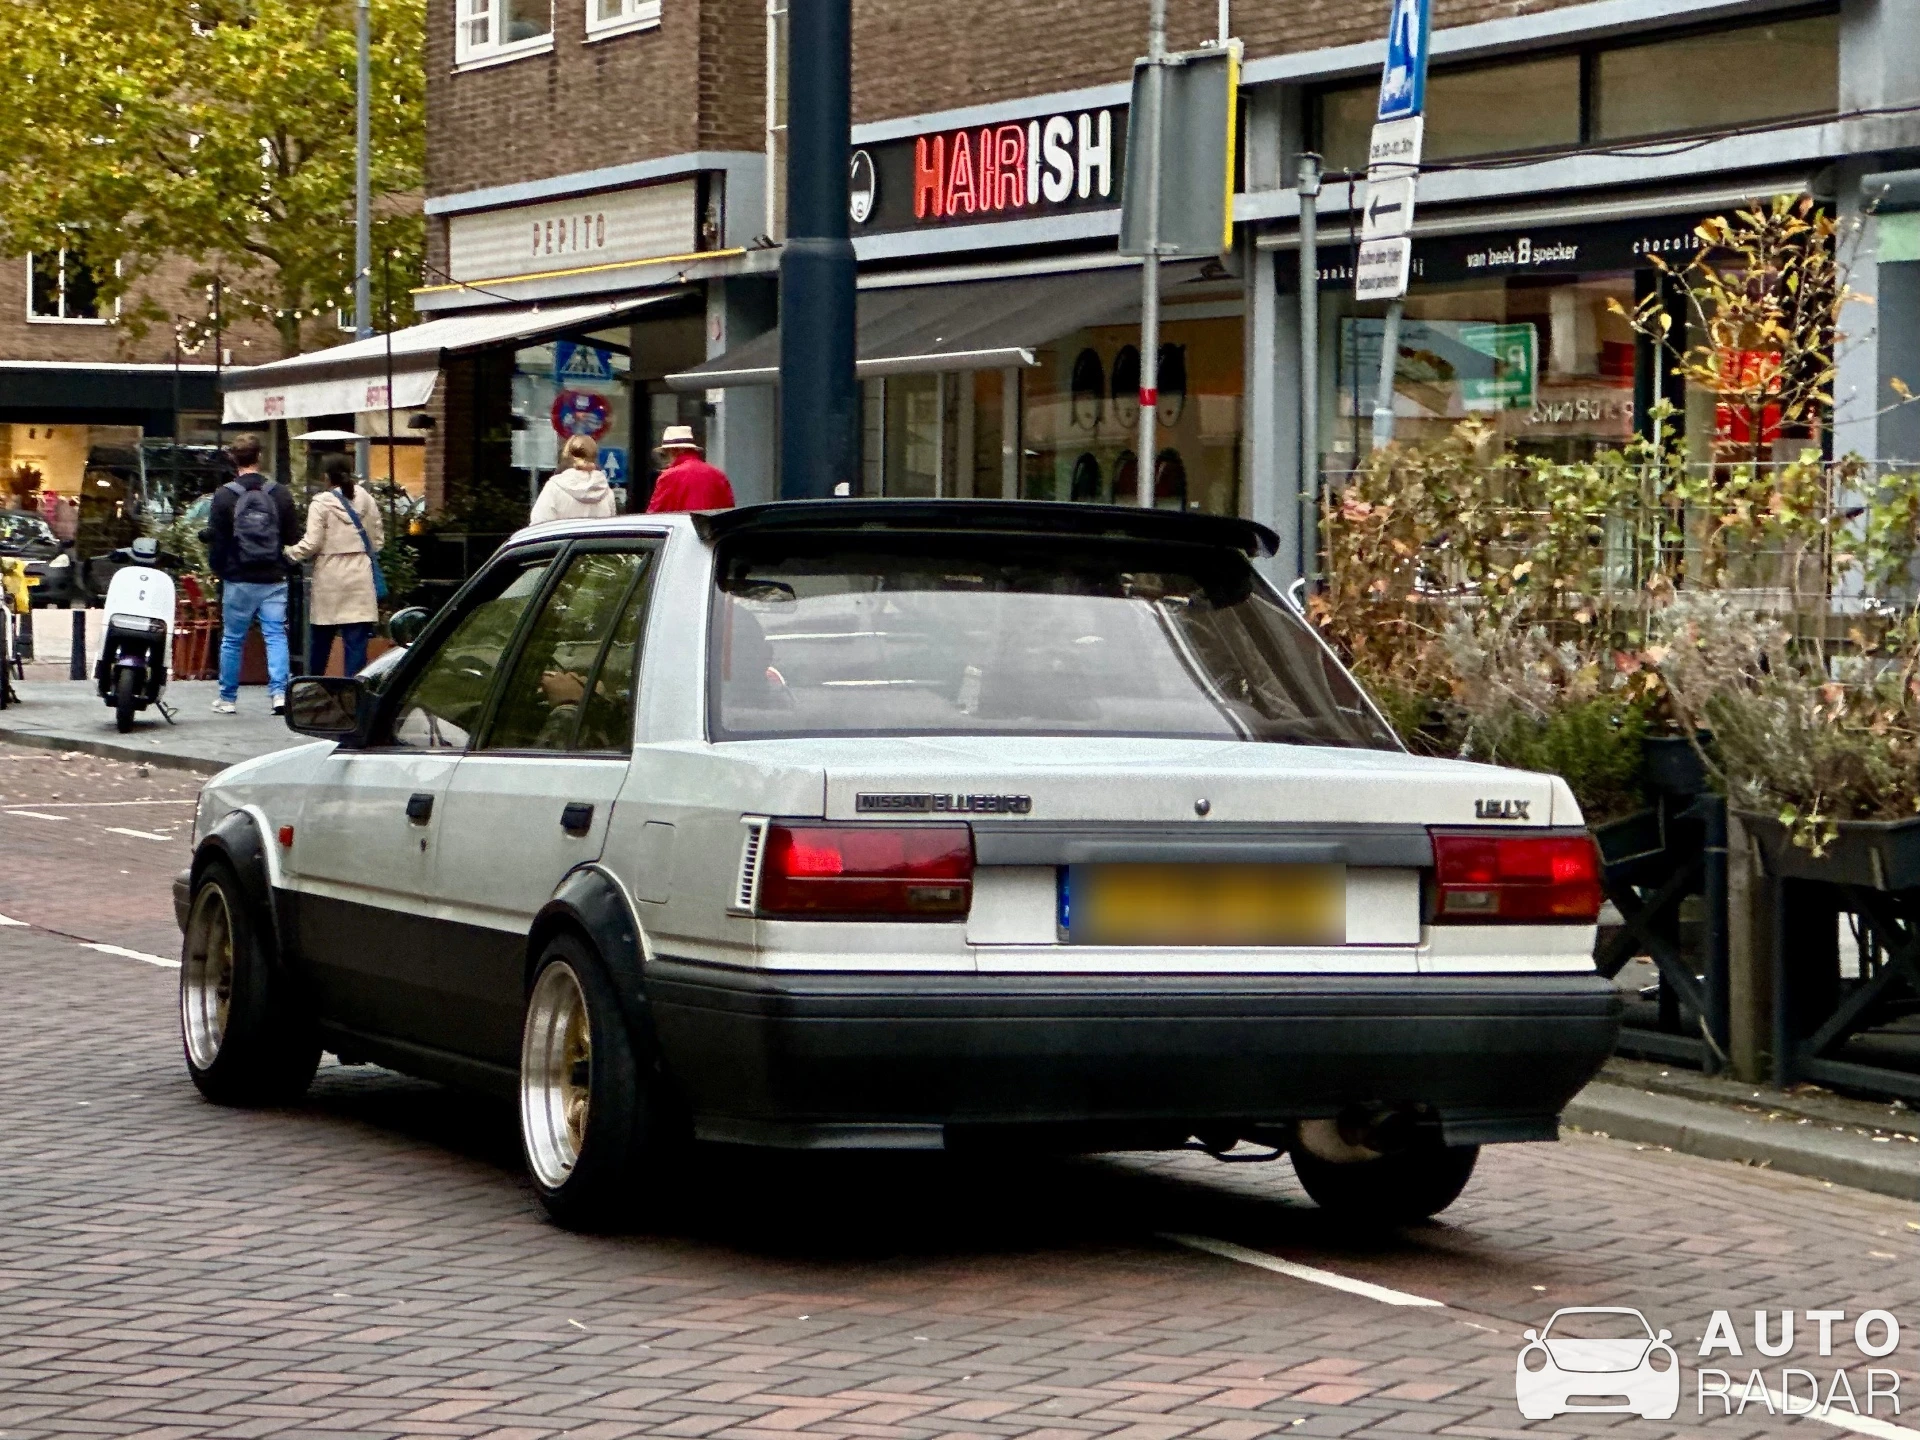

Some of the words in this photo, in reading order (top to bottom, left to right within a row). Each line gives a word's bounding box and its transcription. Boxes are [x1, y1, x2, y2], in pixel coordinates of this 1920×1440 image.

[914, 109, 1112, 219] HAIRISH
[532, 212, 605, 256] PEPITO
[1466, 252, 1486, 267] van
[1488, 245, 1515, 265] beek
[859, 793, 929, 811] NISSAN
[931, 792, 1033, 814] BLUEBIRD
